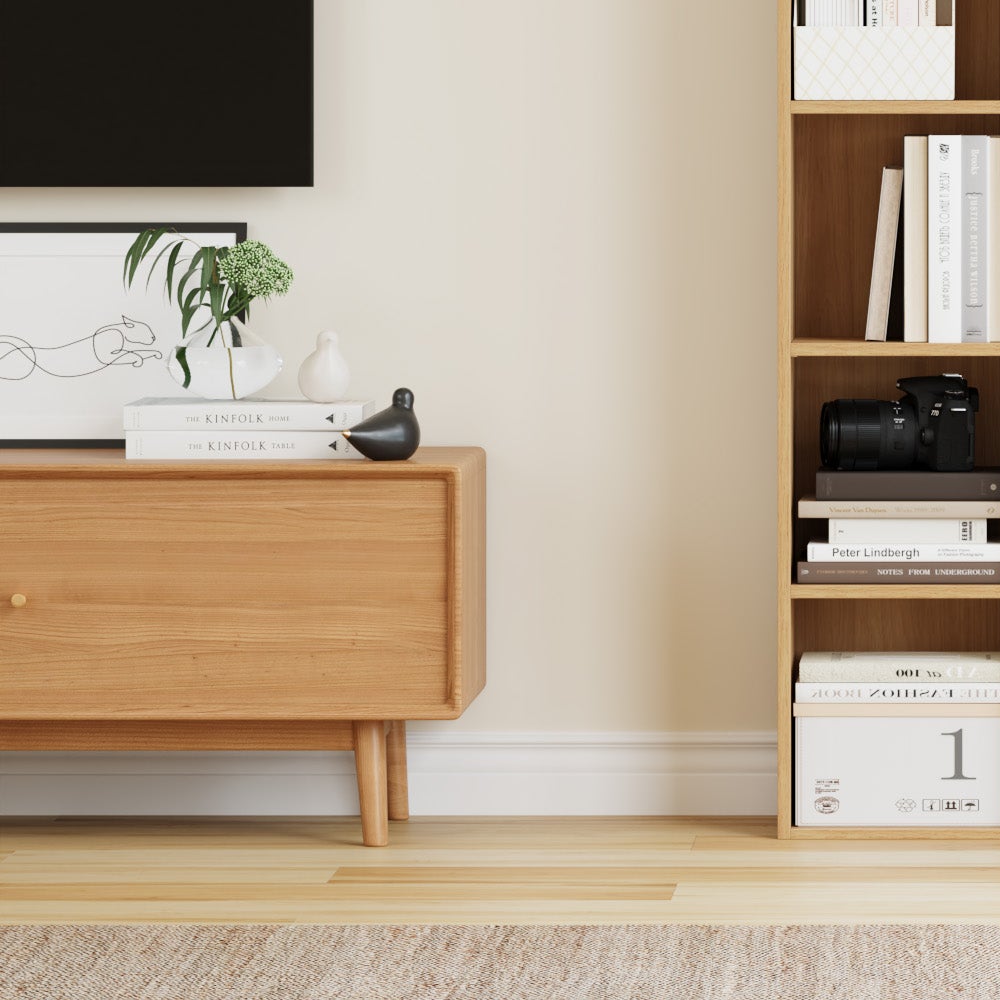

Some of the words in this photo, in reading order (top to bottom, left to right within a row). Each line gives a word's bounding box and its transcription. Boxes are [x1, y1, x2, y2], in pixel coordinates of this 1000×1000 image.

[872, 5, 878, 15] at
[970, 149, 980, 175] Brooks
[205, 414, 264, 424] KINFOLK
[208, 442, 267, 451] KINFOLK
[832, 547, 861, 558] Peter
[864, 547, 920, 560] Lindbergh
[877, 568, 903, 576] NOTES
[908, 568, 931, 576] FROM
[934, 568, 995, 576] UNDERGROUND
[940, 727, 977, 780] 1
